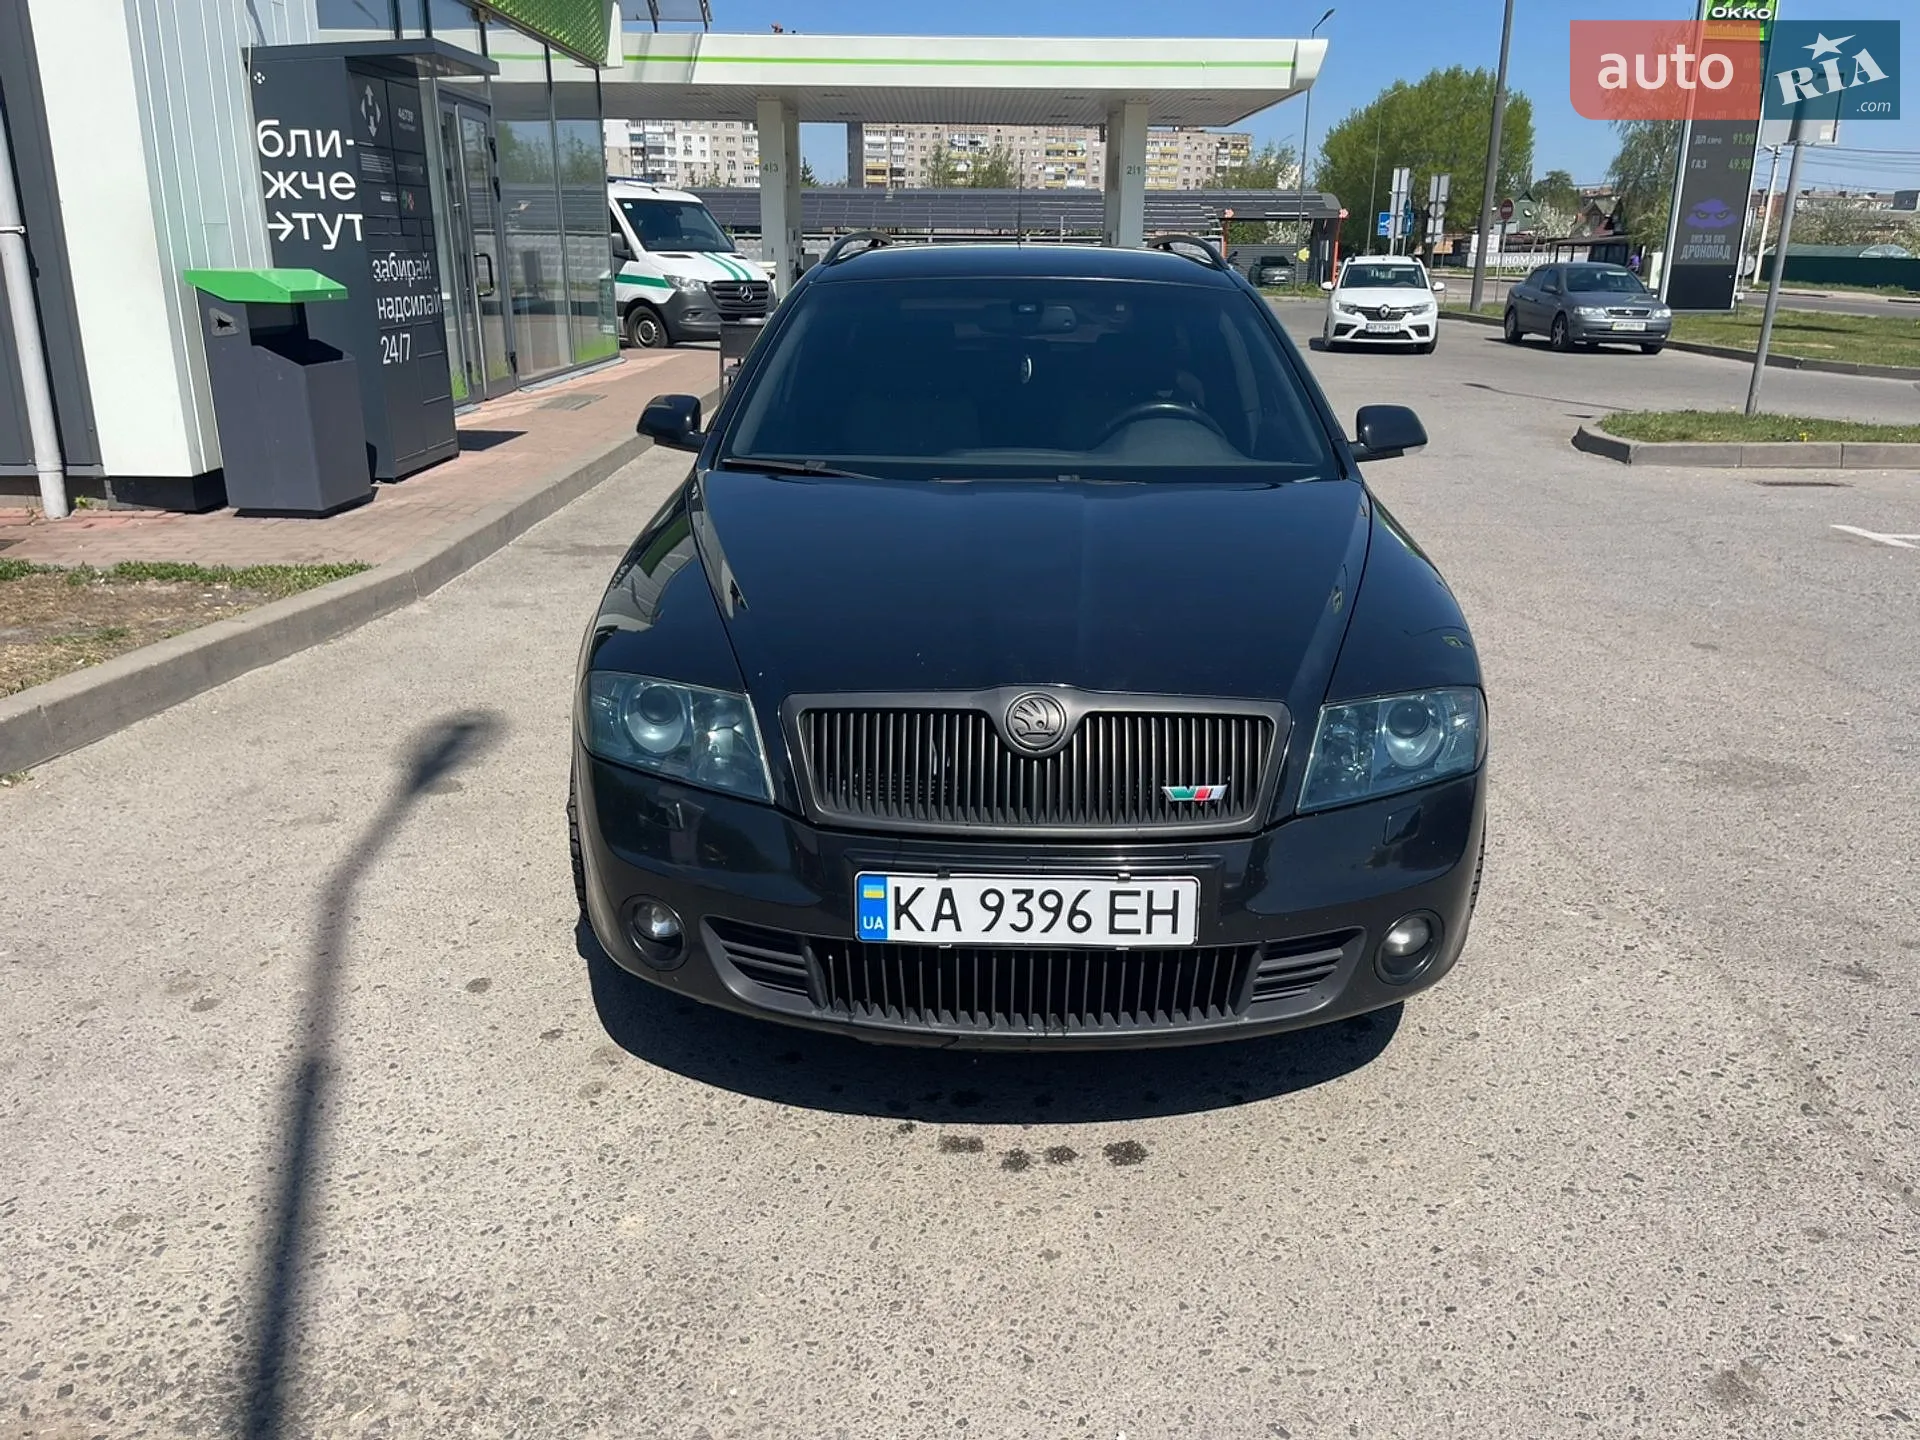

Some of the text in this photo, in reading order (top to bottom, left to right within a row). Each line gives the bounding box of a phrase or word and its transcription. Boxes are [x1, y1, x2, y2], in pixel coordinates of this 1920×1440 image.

[1712, 7, 1772, 19] OKKO
[257, 119, 355, 158] бли-
[262, 169, 357, 201] жче
[291, 212, 364, 250] тут
[372, 252, 431, 288] забирай
[377, 287, 442, 323] надсилай
[380, 332, 411, 365] 24/7
[863, 916, 885, 931] UA
[893, 886, 1180, 935] KA 9396 EH
